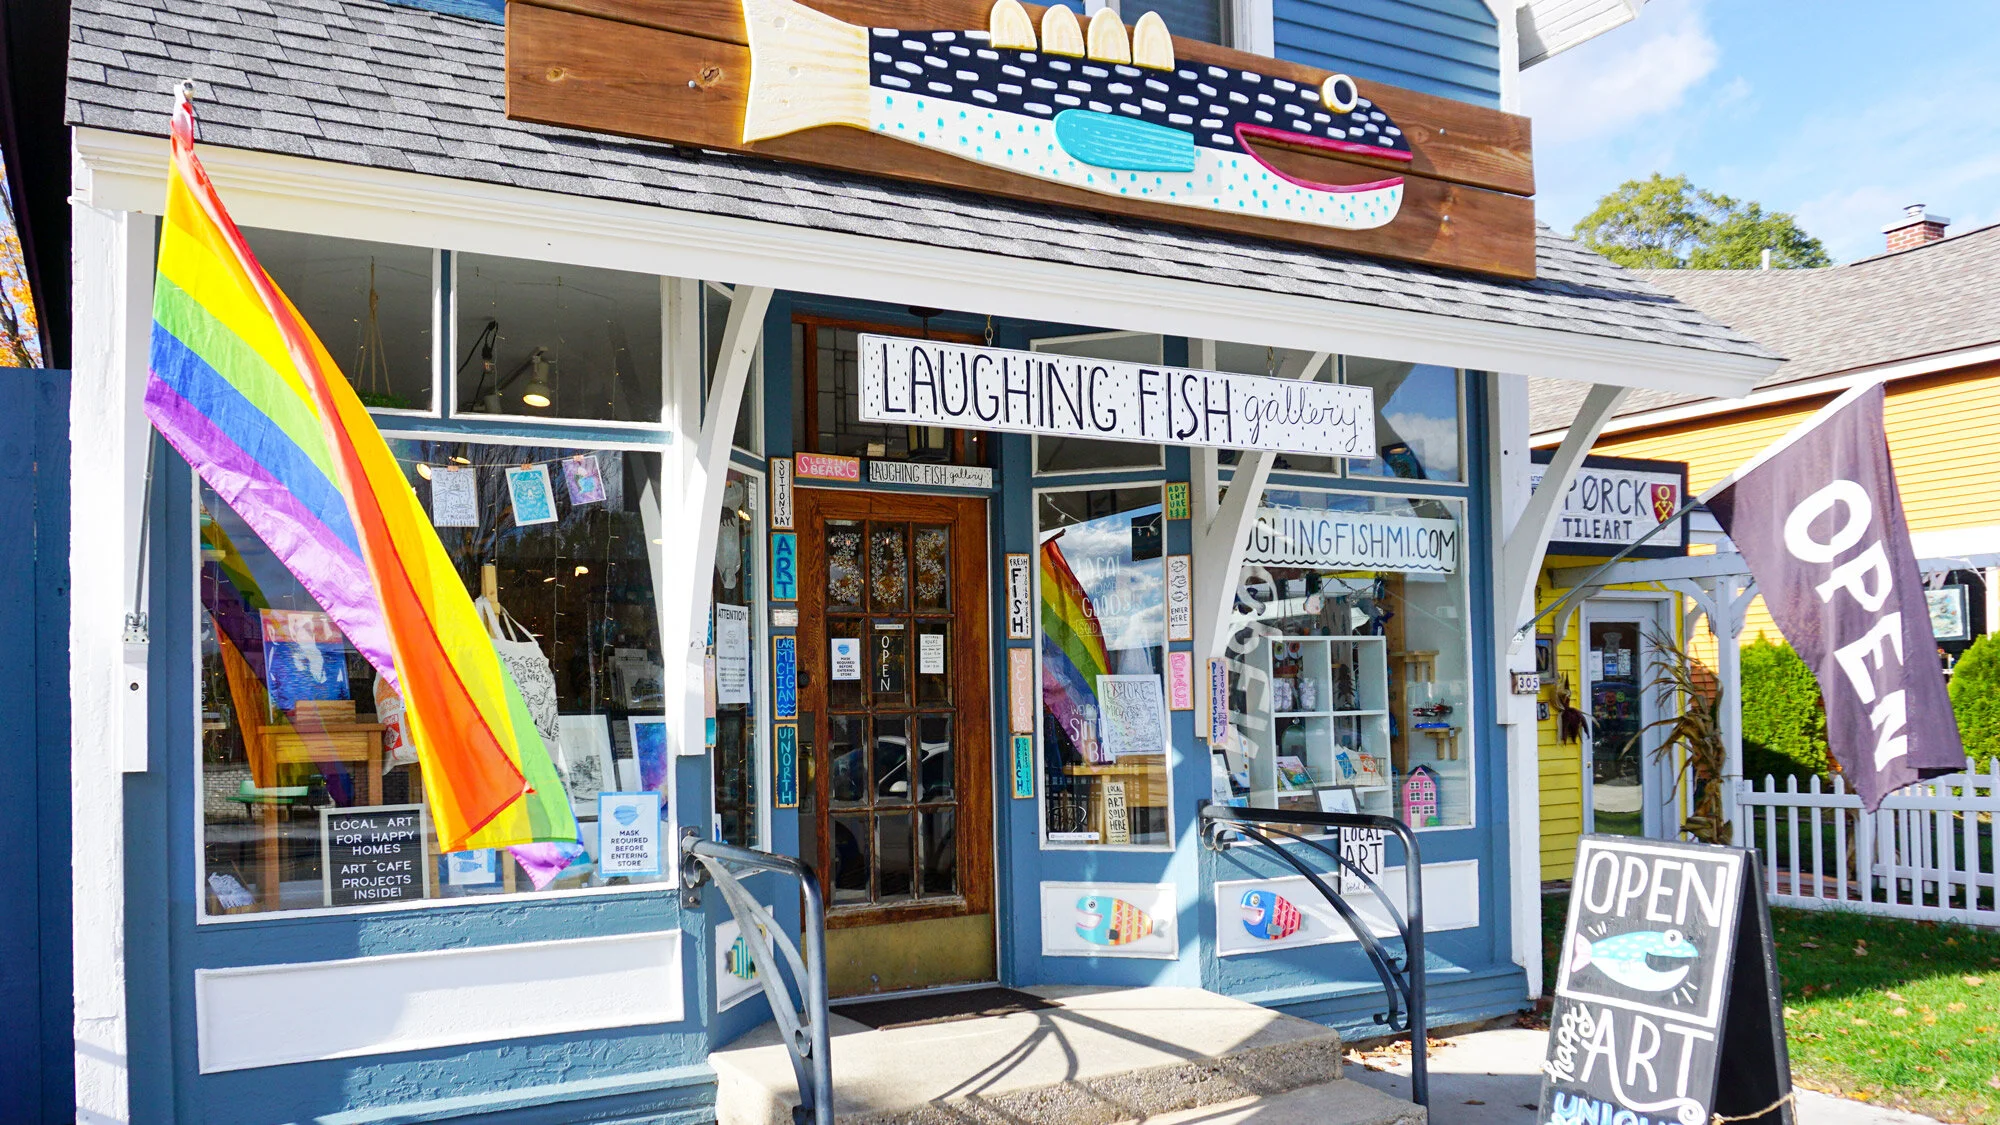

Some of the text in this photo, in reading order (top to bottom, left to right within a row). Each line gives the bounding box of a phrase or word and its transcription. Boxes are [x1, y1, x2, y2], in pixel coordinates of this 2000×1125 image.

[881, 343, 1360, 451] LAUGHING FISH gallery
[799, 456, 857, 479] SLEEPING
[810, 465, 845, 477] BEAR
[871, 461, 984, 486] LAUGHING FISH gallery
[779, 460, 787, 517] SUTTONS
[774, 516, 791, 526] BAY
[1562, 517, 1633, 540] TILEART
[776, 535, 794, 598] ART
[1009, 558, 1028, 567] FRESH
[1074, 555, 1121, 580] LOCAL
[1011, 567, 1024, 633] FISH
[717, 608, 747, 621] ATTENTION
[1170, 606, 1188, 615] ENTER
[1170, 614, 1188, 623] HERE
[1783, 478, 1908, 773] OPEN
[777, 640, 794, 648] LAKE
[880, 635, 890, 692] OPEN
[1105, 681, 1147, 700] EXPLORE
[1519, 676, 1539, 689] 305
[1013, 652, 1027, 731] WELCOME
[779, 728, 794, 739] UP
[780, 740, 792, 803] NORTH
[1015, 738, 1024, 791] BEACH
[1107, 784, 1123, 794] LOCAL
[1108, 796, 1124, 808] ART
[1108, 808, 1126, 820] SOLD
[333, 816, 414, 831] LOCAL ART
[1109, 819, 1127, 831] HERE
[336, 830, 415, 845] FOR HAPPY
[1343, 827, 1382, 843] LOCAL
[352, 843, 401, 856] HOMES
[340, 860, 412, 875] ART CAFE
[1344, 843, 1383, 877] ART
[342, 874, 412, 889] PROJECTS
[1583, 850, 1728, 928] OPEN
[1542, 1002, 1597, 1084] happy
[1580, 1008, 1714, 1108] ART
[1553, 1091, 1685, 1125] UNIQ
